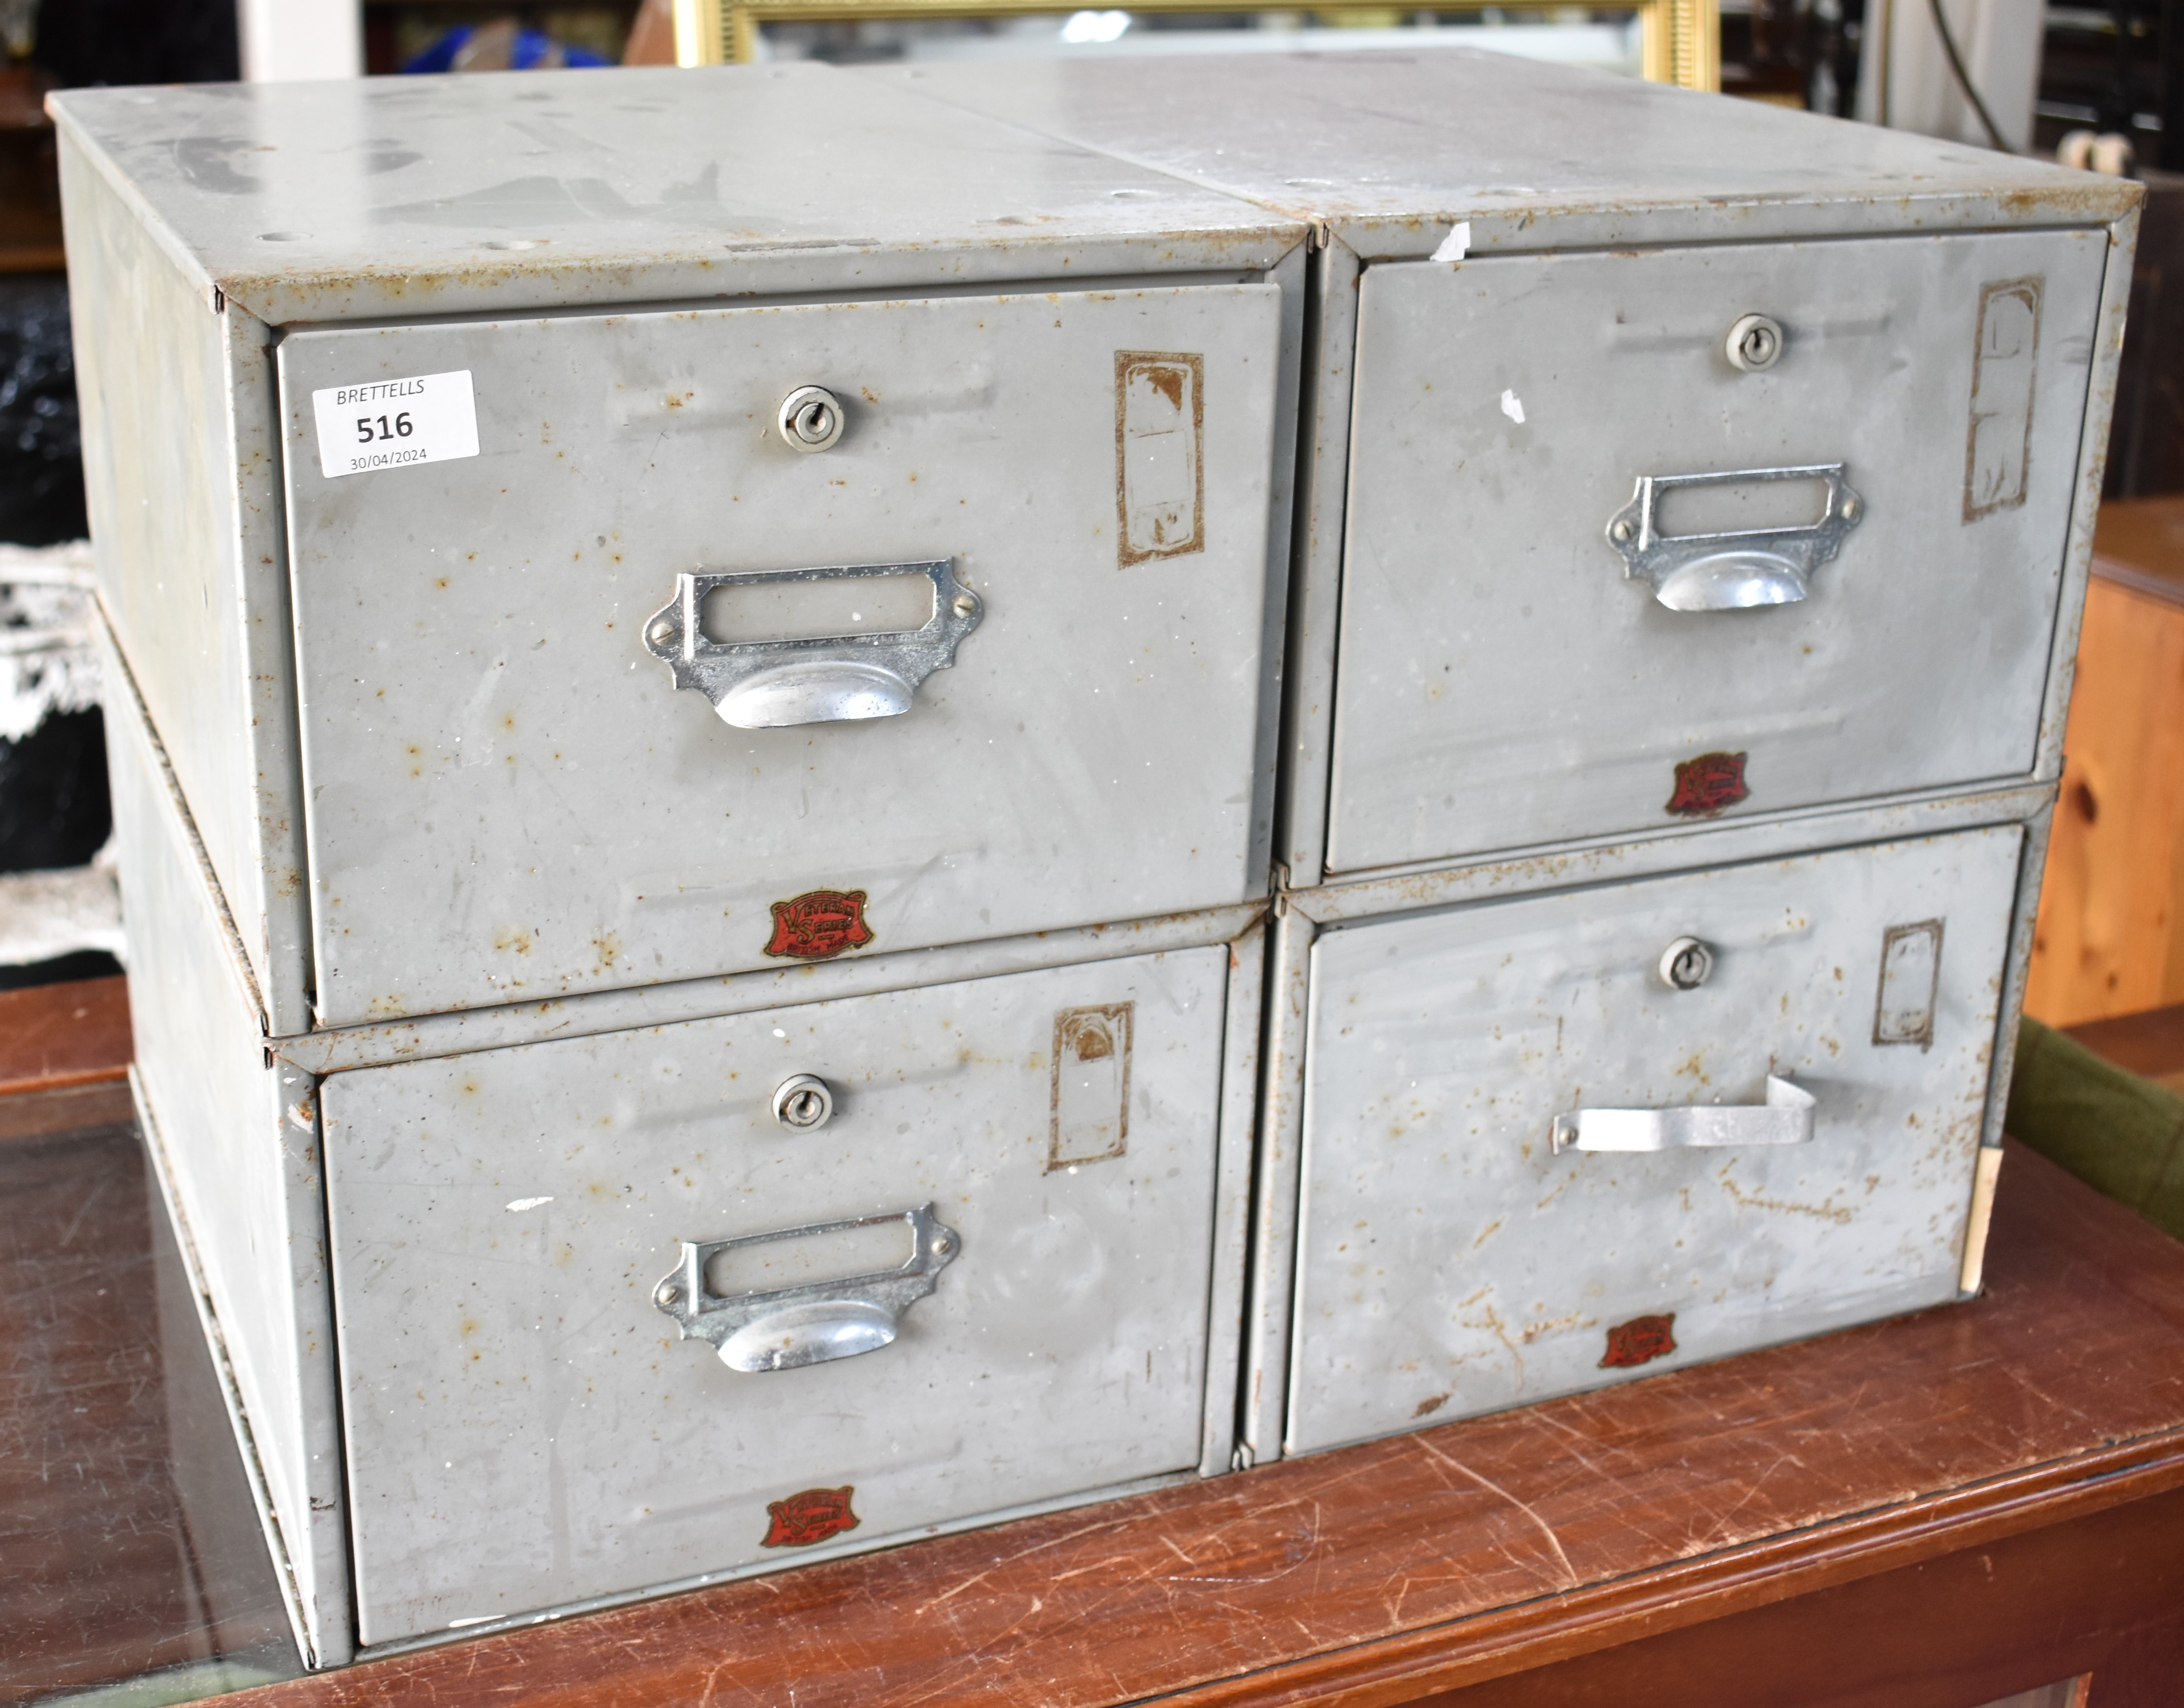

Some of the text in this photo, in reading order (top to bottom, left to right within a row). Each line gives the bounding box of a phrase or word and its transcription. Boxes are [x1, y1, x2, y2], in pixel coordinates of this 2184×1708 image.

[337, 379, 425, 405] BRETTELLS
[357, 412, 413, 443] 516
[350, 448, 427, 470] 30/04/2024
[796, 917, 853, 944] SERIES
